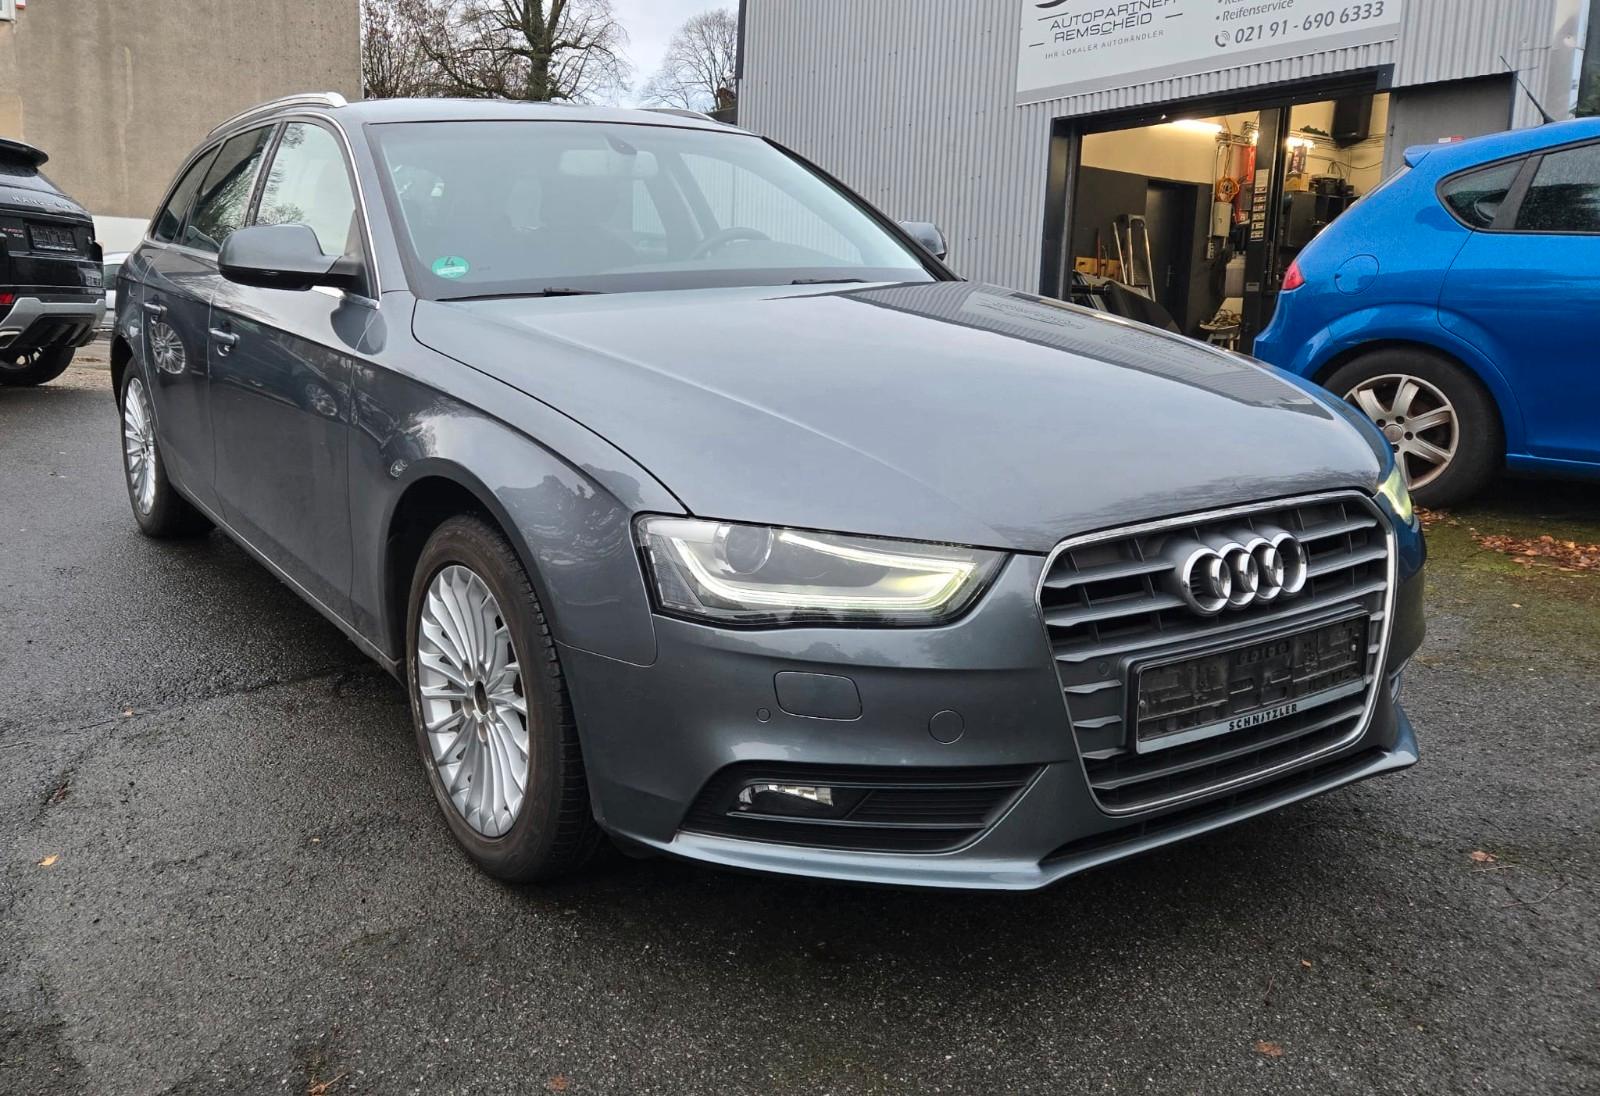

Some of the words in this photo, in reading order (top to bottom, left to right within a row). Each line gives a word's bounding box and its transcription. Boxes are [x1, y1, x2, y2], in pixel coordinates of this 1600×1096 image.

[1222, 0, 1294, 22] Reifenservice
[1235, 24, 1263, 44] 021
[1269, 19, 1289, 37] 91
[1302, 10, 1335, 31] 690
[1339, 1, 1384, 24] 6333
[1054, 12, 1153, 43] REMSCHEID
[1045, 51, 1059, 60] IHR
[1061, 44, 1098, 57] LOKALER
[1101, 29, 1164, 49] AUTOHÄNDLER
[1229, 703, 1297, 731] SCHNITZLER
